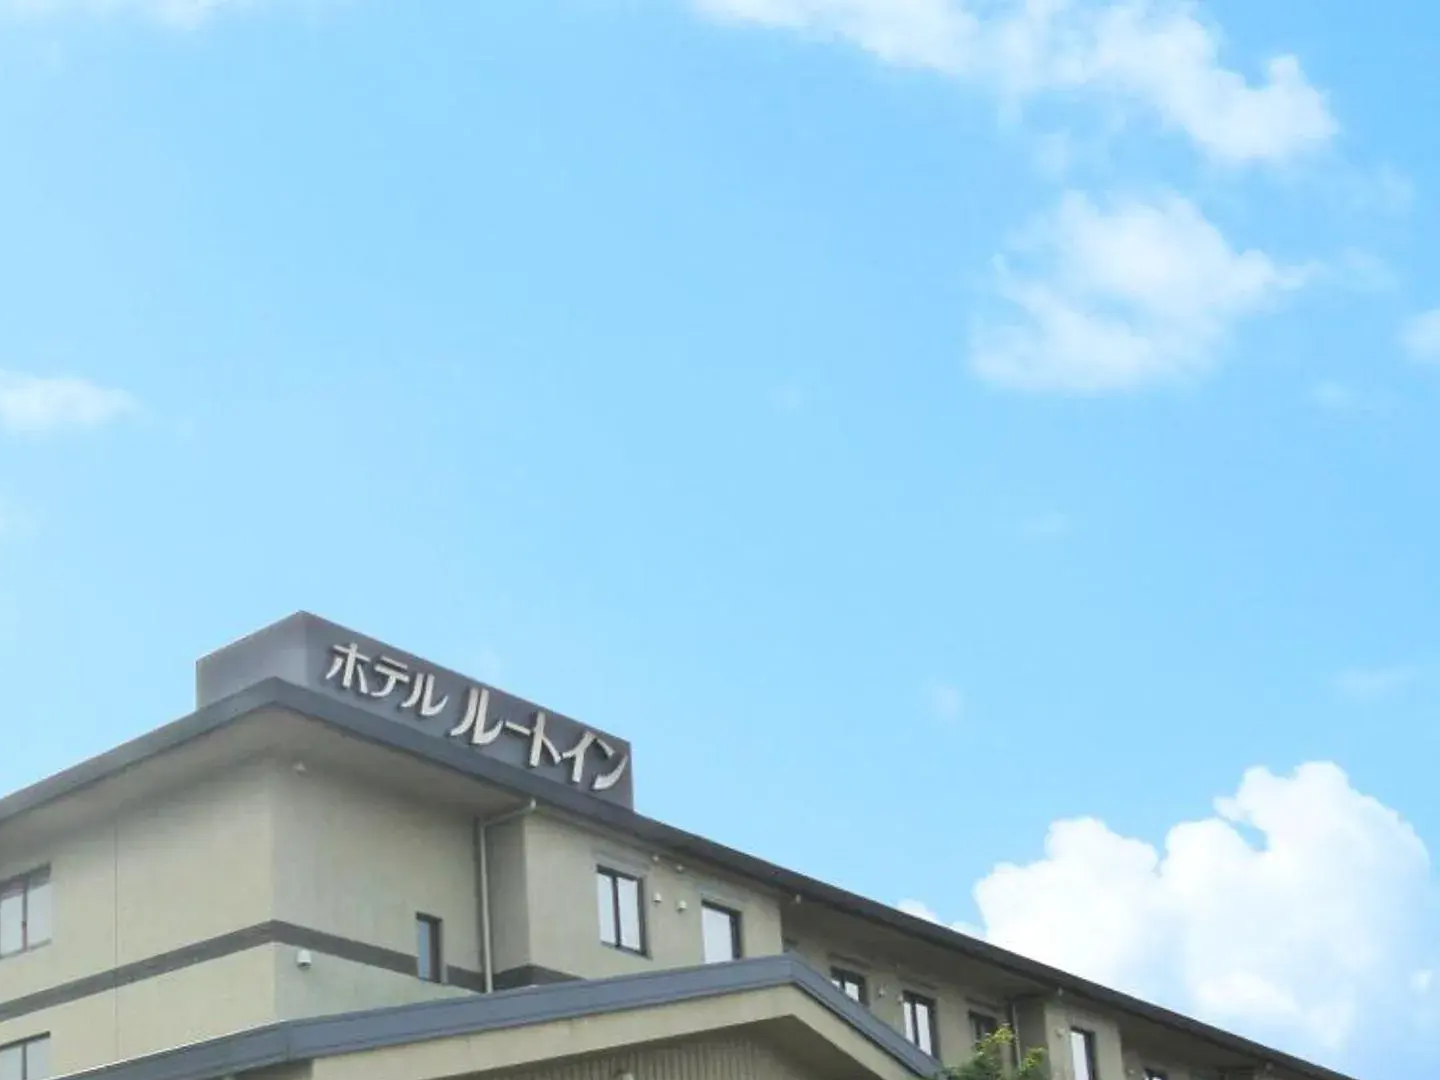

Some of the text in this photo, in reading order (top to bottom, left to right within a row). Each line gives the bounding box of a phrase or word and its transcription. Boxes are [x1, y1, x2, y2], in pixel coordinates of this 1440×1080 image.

[325, 643, 629, 791] ホテル ルートイン
